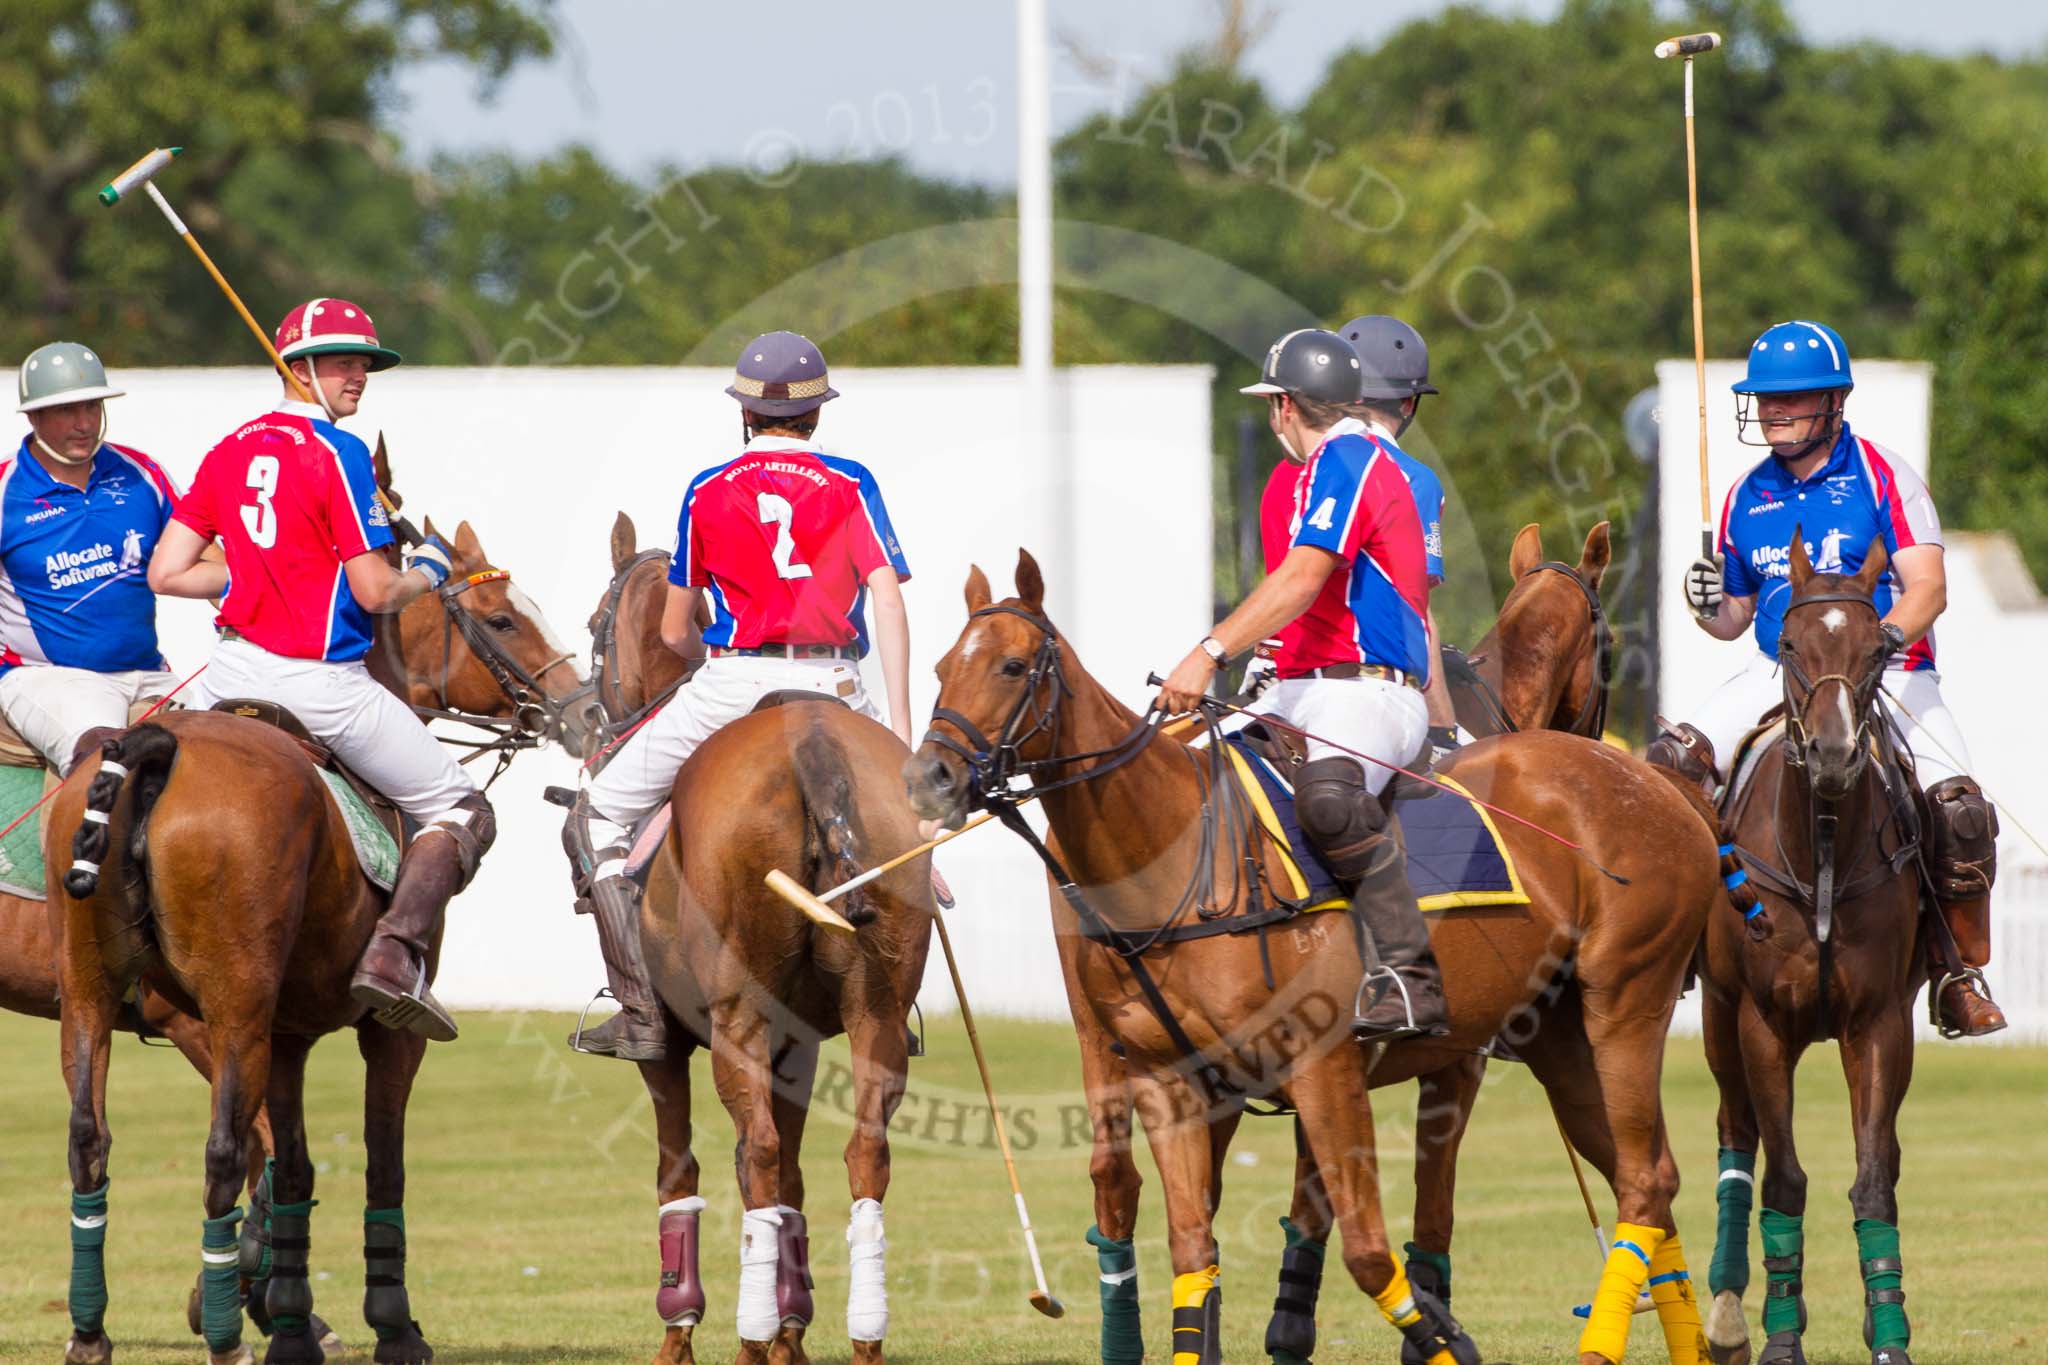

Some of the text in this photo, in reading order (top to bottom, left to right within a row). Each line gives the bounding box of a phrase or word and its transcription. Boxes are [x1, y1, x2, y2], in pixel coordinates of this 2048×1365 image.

[763, 461, 830, 487] ARTILLERY
[240, 455, 280, 549] 3
[1307, 496, 1337, 531] 4
[757, 492, 813, 579] 2
[46, 542, 113, 574] Allocate
[48, 561, 119, 590] Software
